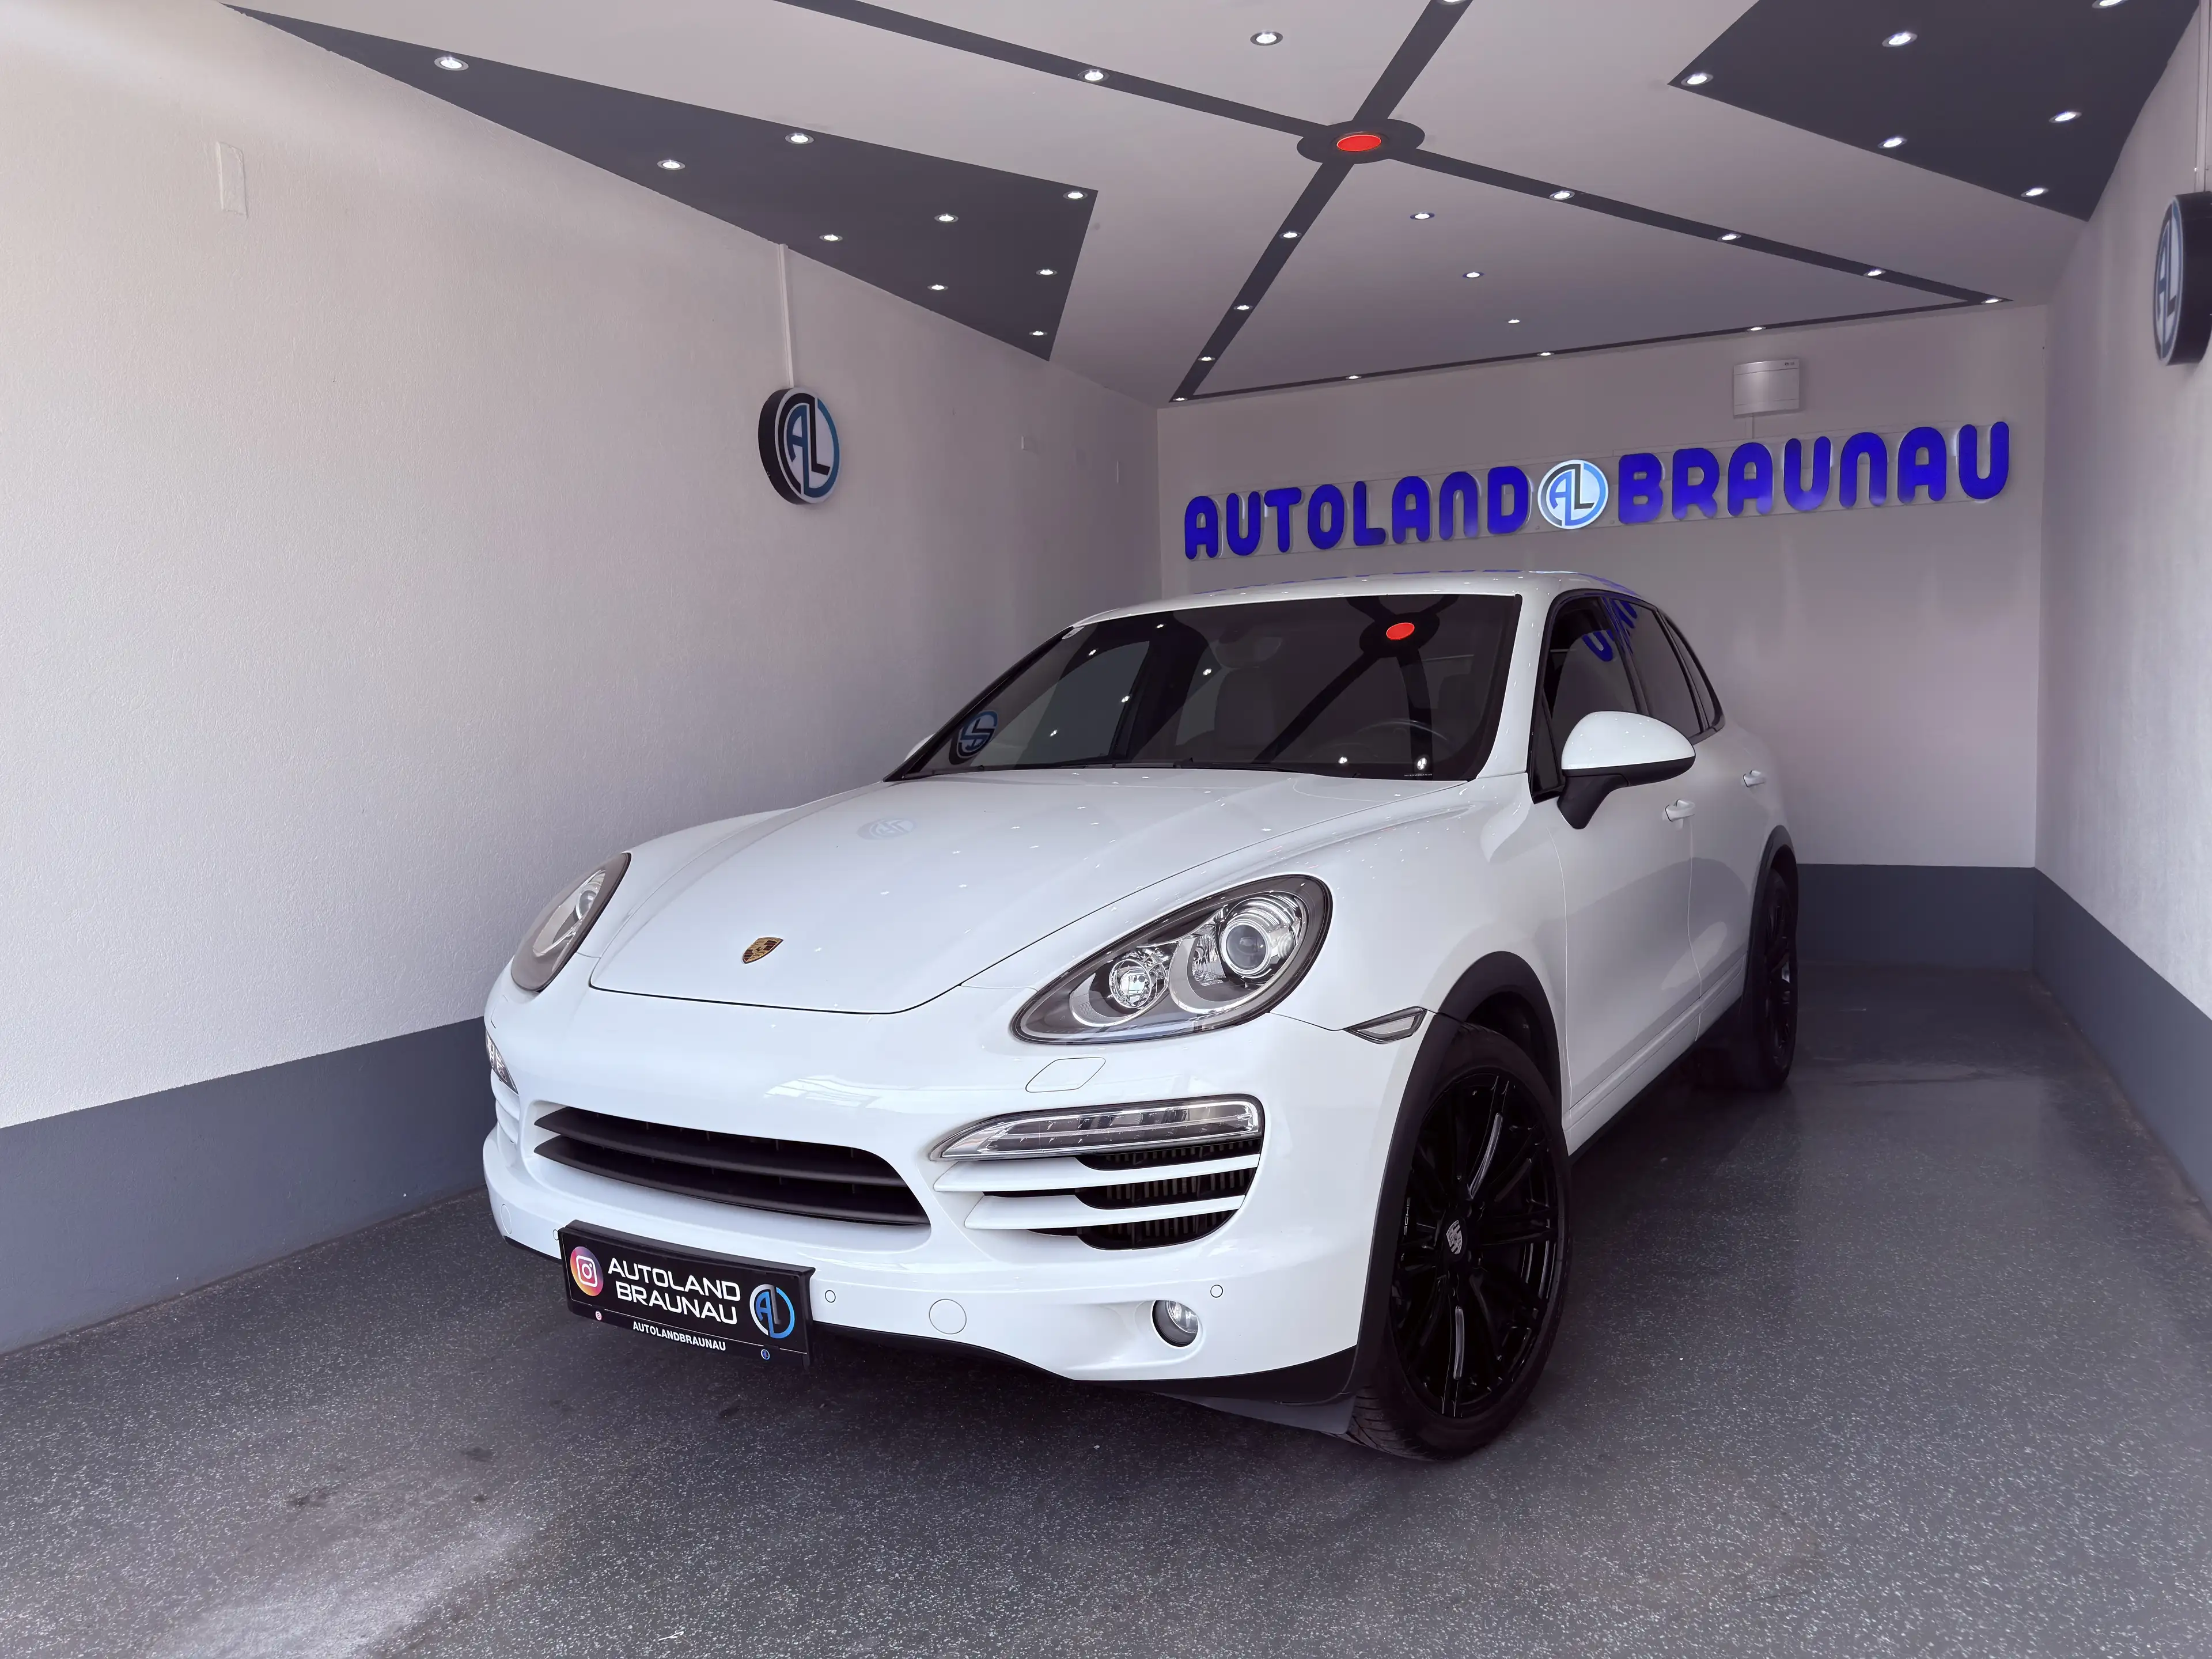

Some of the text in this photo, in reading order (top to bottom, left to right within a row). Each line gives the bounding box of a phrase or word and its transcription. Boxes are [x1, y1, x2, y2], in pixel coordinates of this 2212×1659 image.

[1184, 466, 1530, 559] AUTOLAND
[1618, 421, 2009, 524] BRAUNAU
[608, 1257, 741, 1302] AUTOLAND
[615, 1281, 737, 1325] BRAUNAU
[632, 1321, 726, 1351] AUTOLANDBRAUNAU
